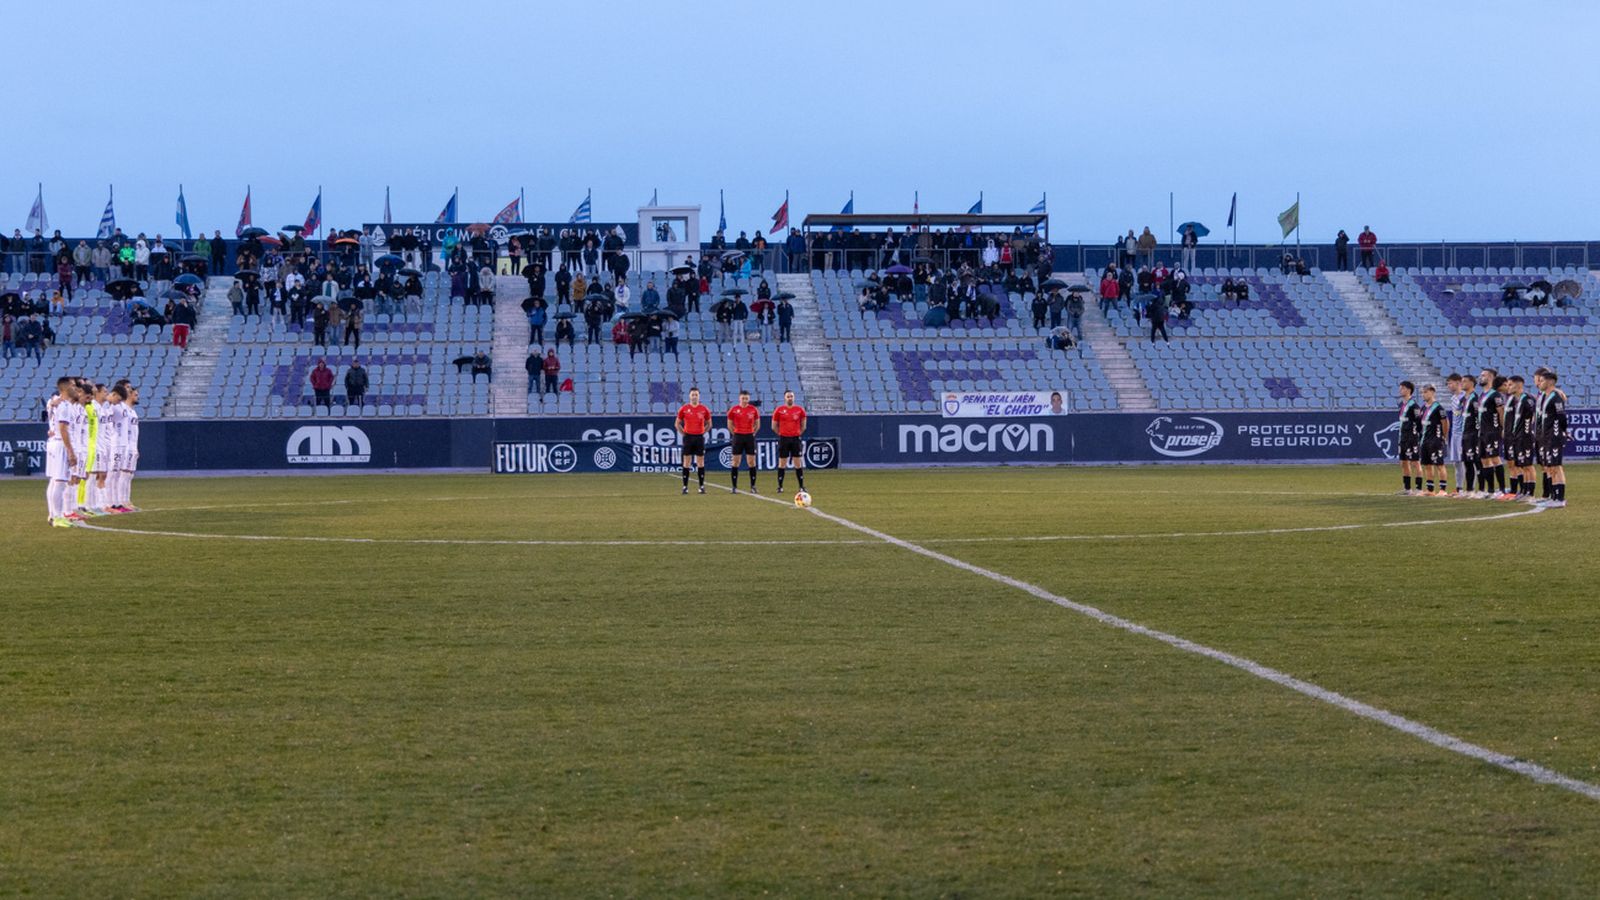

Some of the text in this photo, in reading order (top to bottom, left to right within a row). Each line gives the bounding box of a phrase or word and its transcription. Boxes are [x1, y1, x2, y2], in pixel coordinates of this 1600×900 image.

[493, 231, 504, 239] 30
[988, 394, 1009, 403] REAL
[1011, 393, 1036, 403] JAÉN
[1237, 424, 1366, 435] PROTECCION Y
[898, 423, 1054, 453] macron
[1164, 432, 1222, 449] proseja
[1250, 436, 1352, 447] SEGURIDAD
[496, 444, 549, 472] FUTUR
[633, 445, 698, 465] SEGUN
